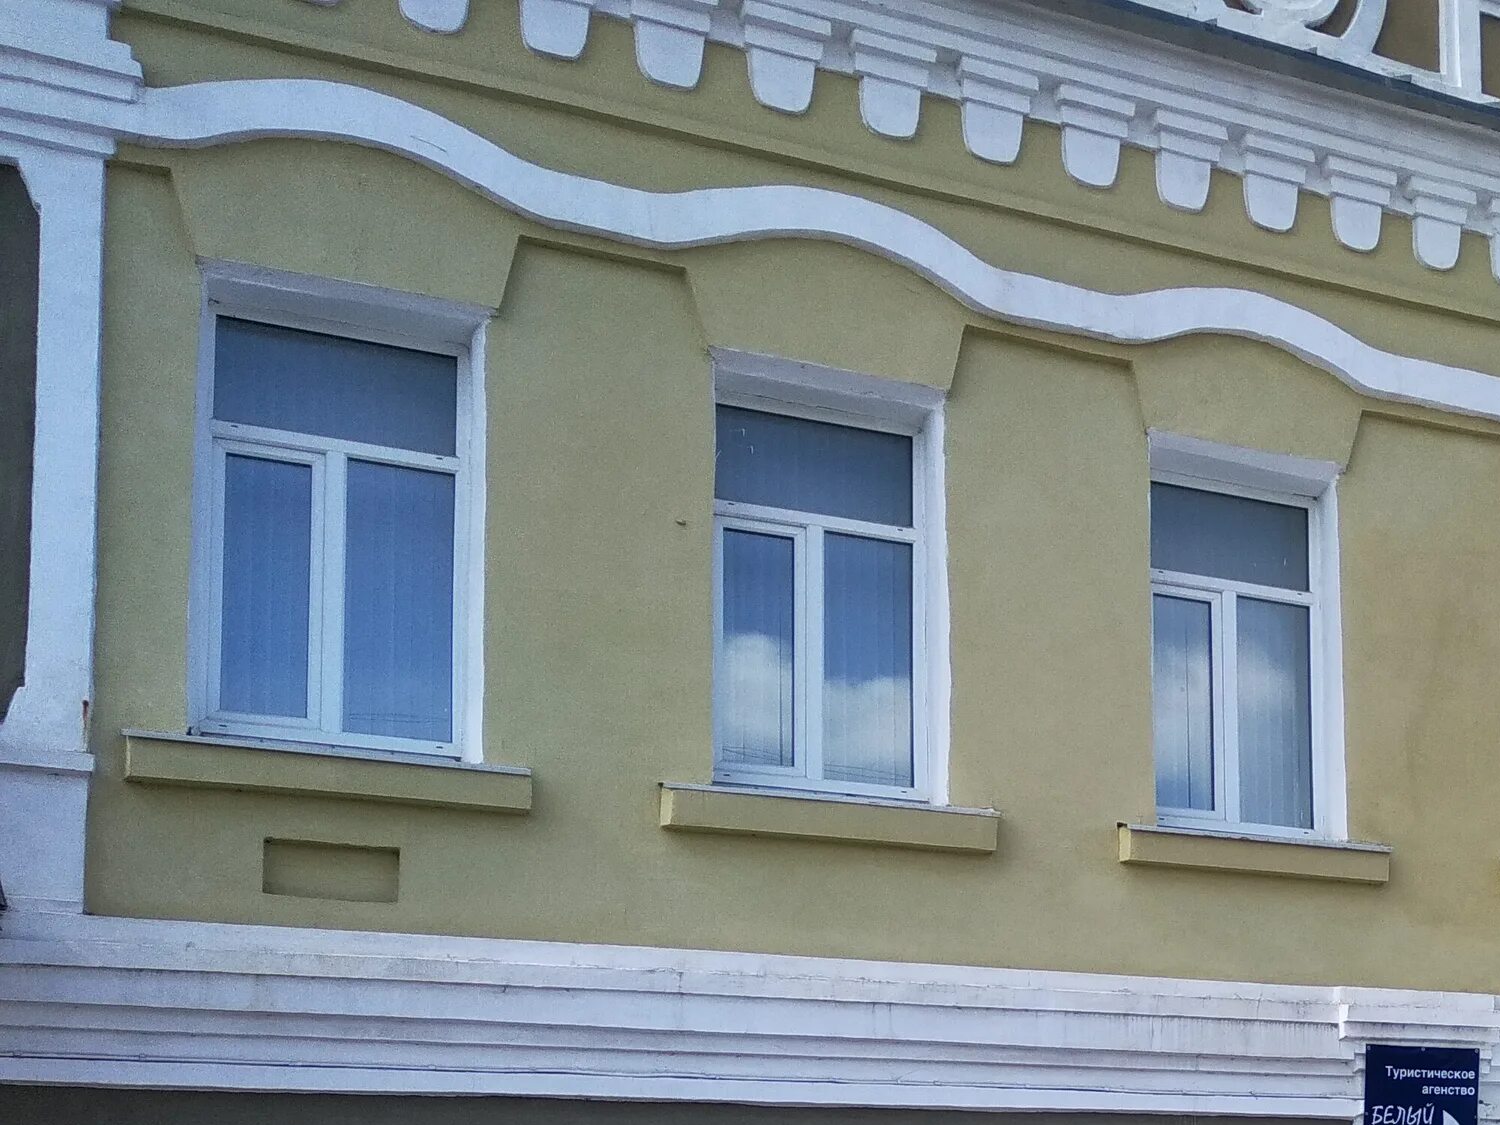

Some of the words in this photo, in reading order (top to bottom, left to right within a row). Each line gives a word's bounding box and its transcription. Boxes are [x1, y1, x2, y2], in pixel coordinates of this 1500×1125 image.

[1385, 1065, 1475, 1080] Туристическое
[1421, 1085, 1475, 1096] агенство
[1371, 1103, 1435, 1125] БЕЛЫЙ
